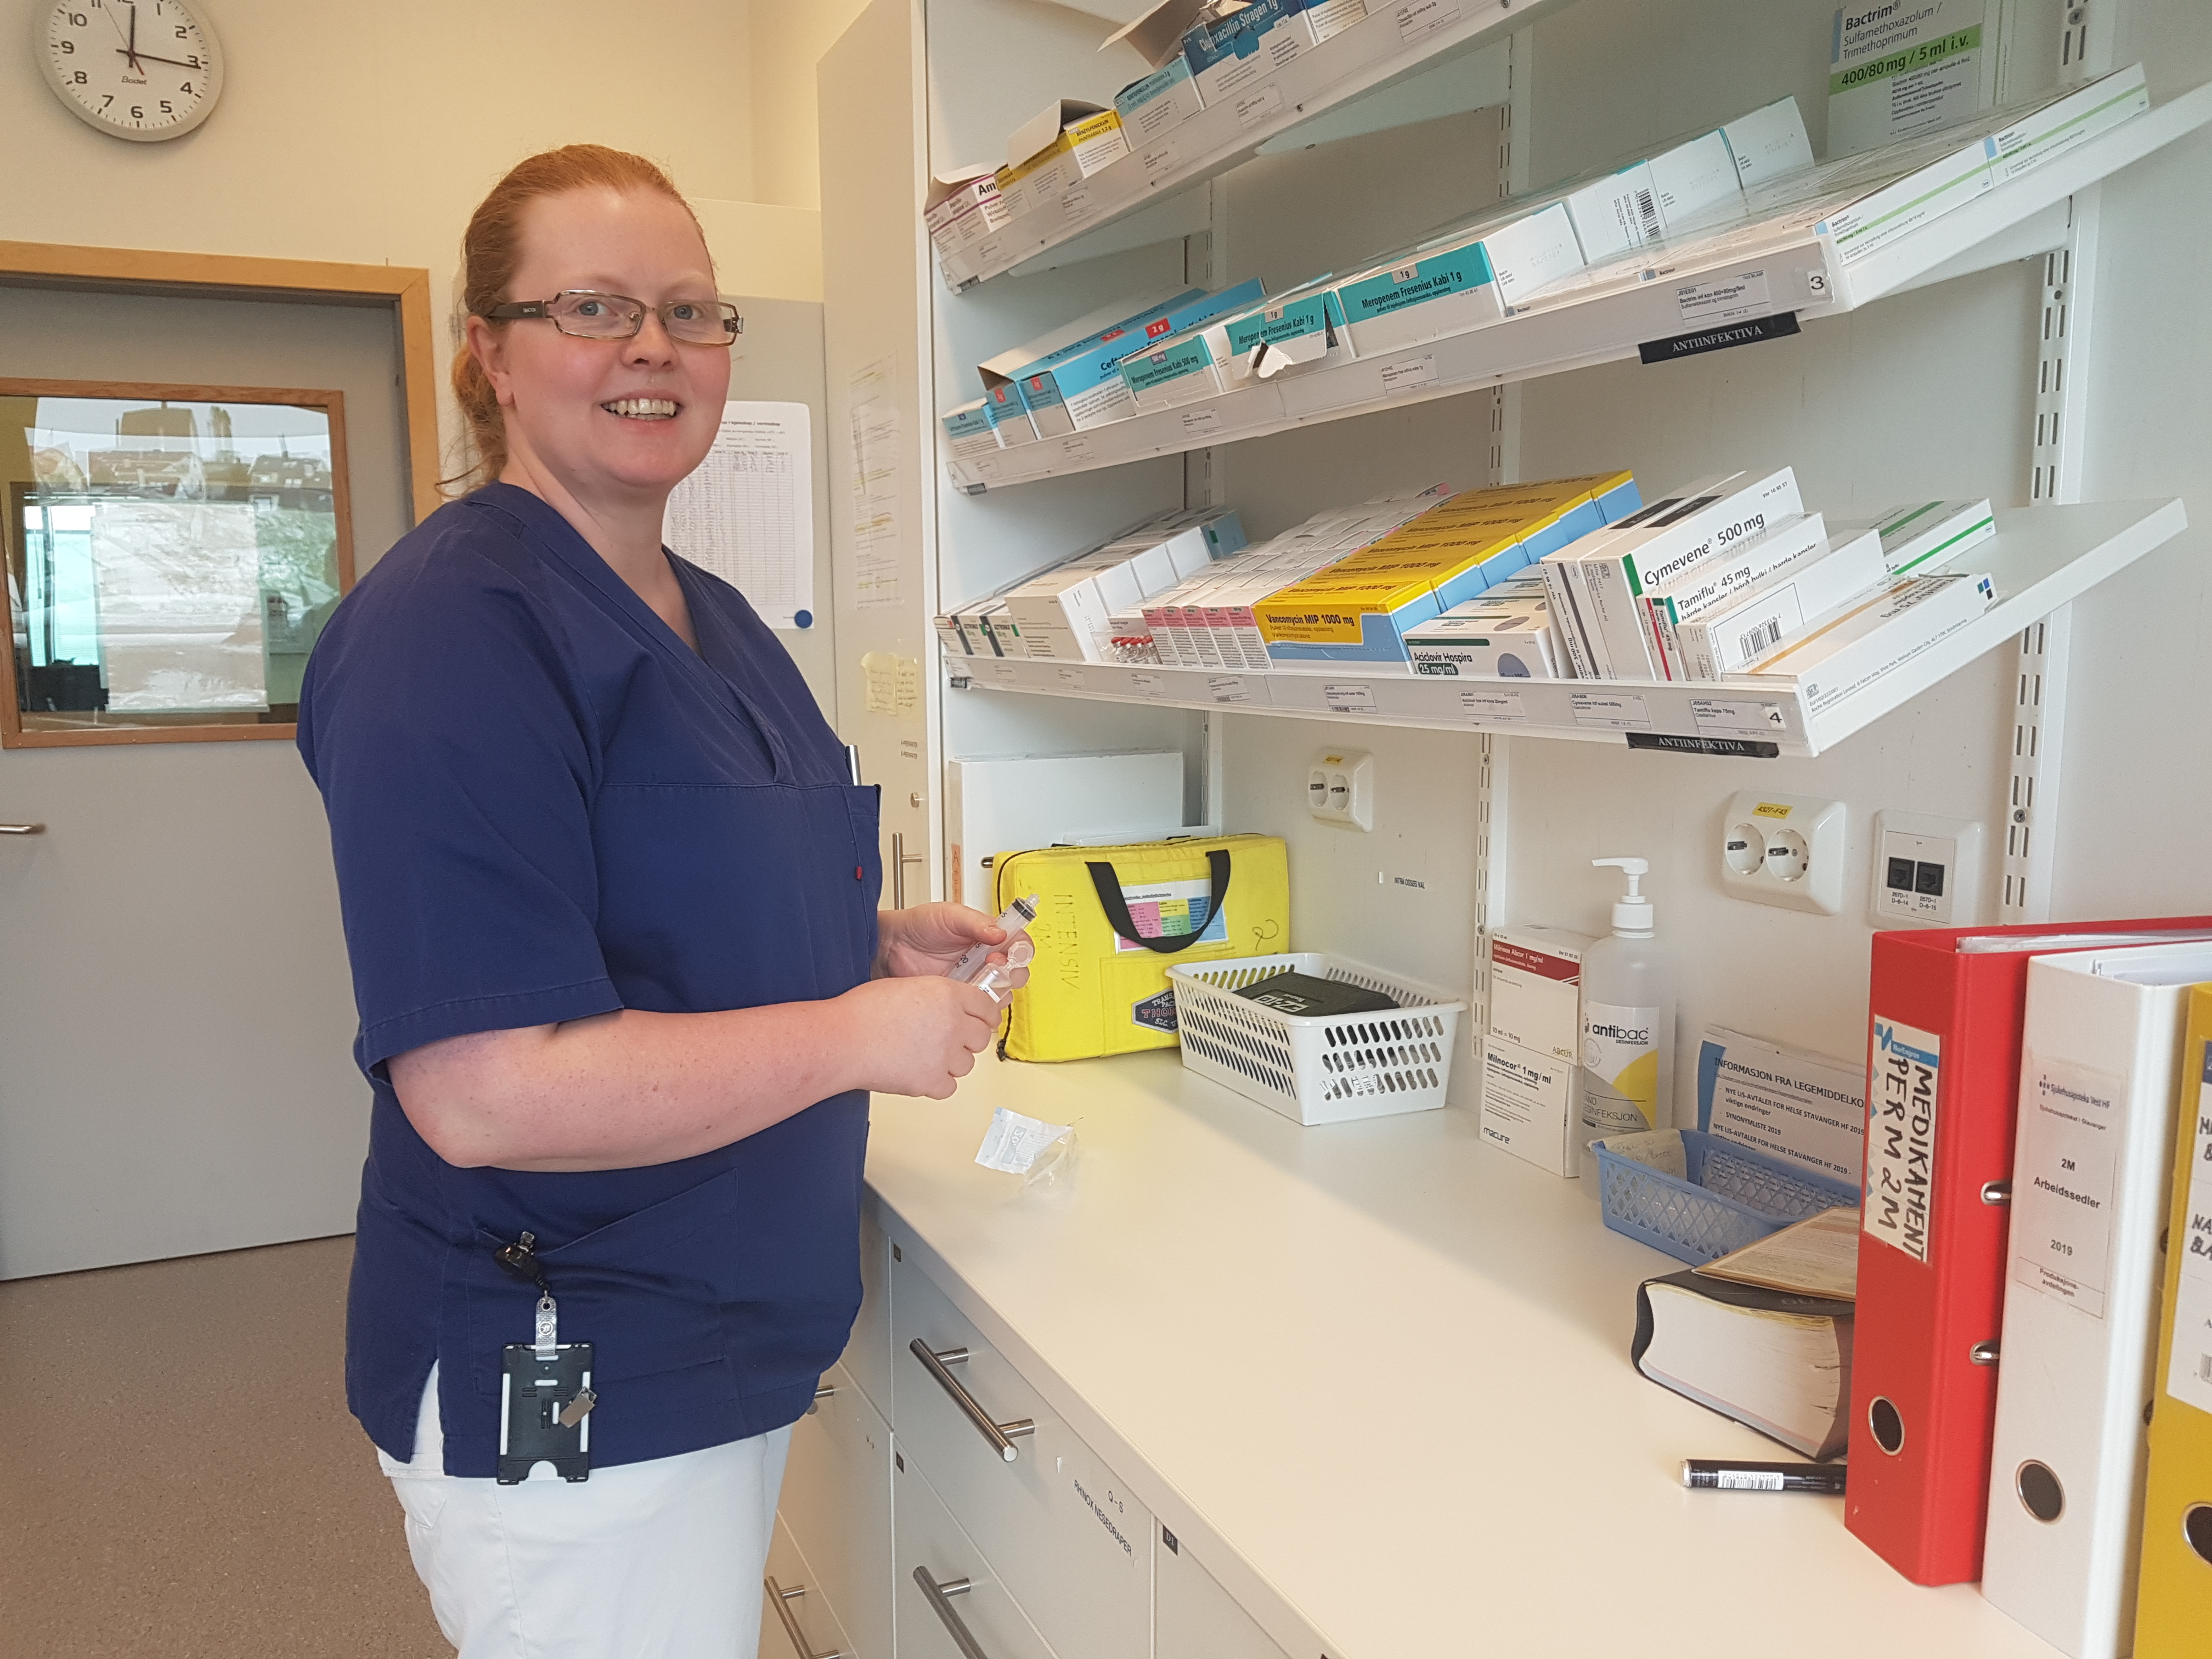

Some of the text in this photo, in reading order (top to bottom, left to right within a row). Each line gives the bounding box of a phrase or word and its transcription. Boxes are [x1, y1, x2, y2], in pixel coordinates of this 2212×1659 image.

[68, 12, 88, 27] 10
[1239, 2, 1267, 27] Stragen
[175, 26, 187, 39] 2
[1844, 8, 1934, 47] Sulfamethoxazolum
[61, 41, 75, 54] 9
[1843, 26, 1918, 60] Trimethoprimum
[1842, 61, 1884, 86] 400/80
[1886, 57, 1906, 72] mg
[1920, 47, 1927, 61] 5
[1930, 43, 1946, 58] ml
[1950, 35, 1969, 50] i.v.
[74, 71, 88, 84] 8
[121, 76, 147, 86] Bodet
[180, 82, 192, 94] 4
[101, 95, 114, 108] 7
[160, 100, 172, 114] 5
[131, 106, 143, 119] 6
[1361, 291, 1400, 309] Meropenem
[1400, 280, 1432, 297] Fresenius
[1432, 274, 1450, 287] Kabi
[1810, 276, 1824, 290] 3
[1268, 322, 1292, 336] Fresenius
[1293, 315, 1305, 329] Kabi
[1673, 325, 1764, 352] ANTIINFEKTIVA
[1717, 522, 1742, 546] 500
[1743, 513, 1765, 532] mg
[1722, 574, 1734, 588] 45
[1735, 566, 1751, 580] mg
[1265, 614, 1355, 627] Vancomycin MIP 1000 mg
[1413, 651, 1473, 664] Aciclovir Hospira
[1419, 663, 1455, 676] 25 mg/ml
[1769, 712, 1782, 724] 4
[1658, 737, 1745, 752] ANTIINFEKTIVA
[1053, 894, 1080, 990] INTENSIV
[961, 954, 969, 963] 20
[1592, 1023, 1649, 1041] antibac
[1551, 1046, 1573, 1059] ABCUR
[1714, 1057, 1773, 1081] INFORMASJON
[1775, 1075, 1792, 1087] FRA
[1794, 1080, 1864, 1109] LEGEMIDDELKO
[1725, 1096, 1771, 1116] viktige endringer
[1725, 1087, 1737, 1096] NYE
[1737, 1090, 1773, 1107] LIS-AVTALER
[1773, 1101, 1785, 1111] FOR
[1785, 1105, 1803, 1117] HELSE
[1803, 1111, 1840, 1128] STAVANGER
[1841, 1122, 1849, 1131] HF
[1725, 1111, 1782, 1136] SYNONYMLISTE 2019
[1483, 1126, 1510, 1144] macure
[1713, 1122, 1848, 1176] NYE LIS-AVTALER FOR HELSE STAVANGER HF 2019
[1902, 1064, 1933, 1263] MEDIKAMENT
[2061, 1158, 2076, 1172] 2M
[2033, 1176, 2101, 1210] Arbeidssedler
[2050, 1239, 2073, 1257] 2019
[1074, 1479, 1094, 1511] RHINOX
[1108, 1491, 1124, 1514] Q S
